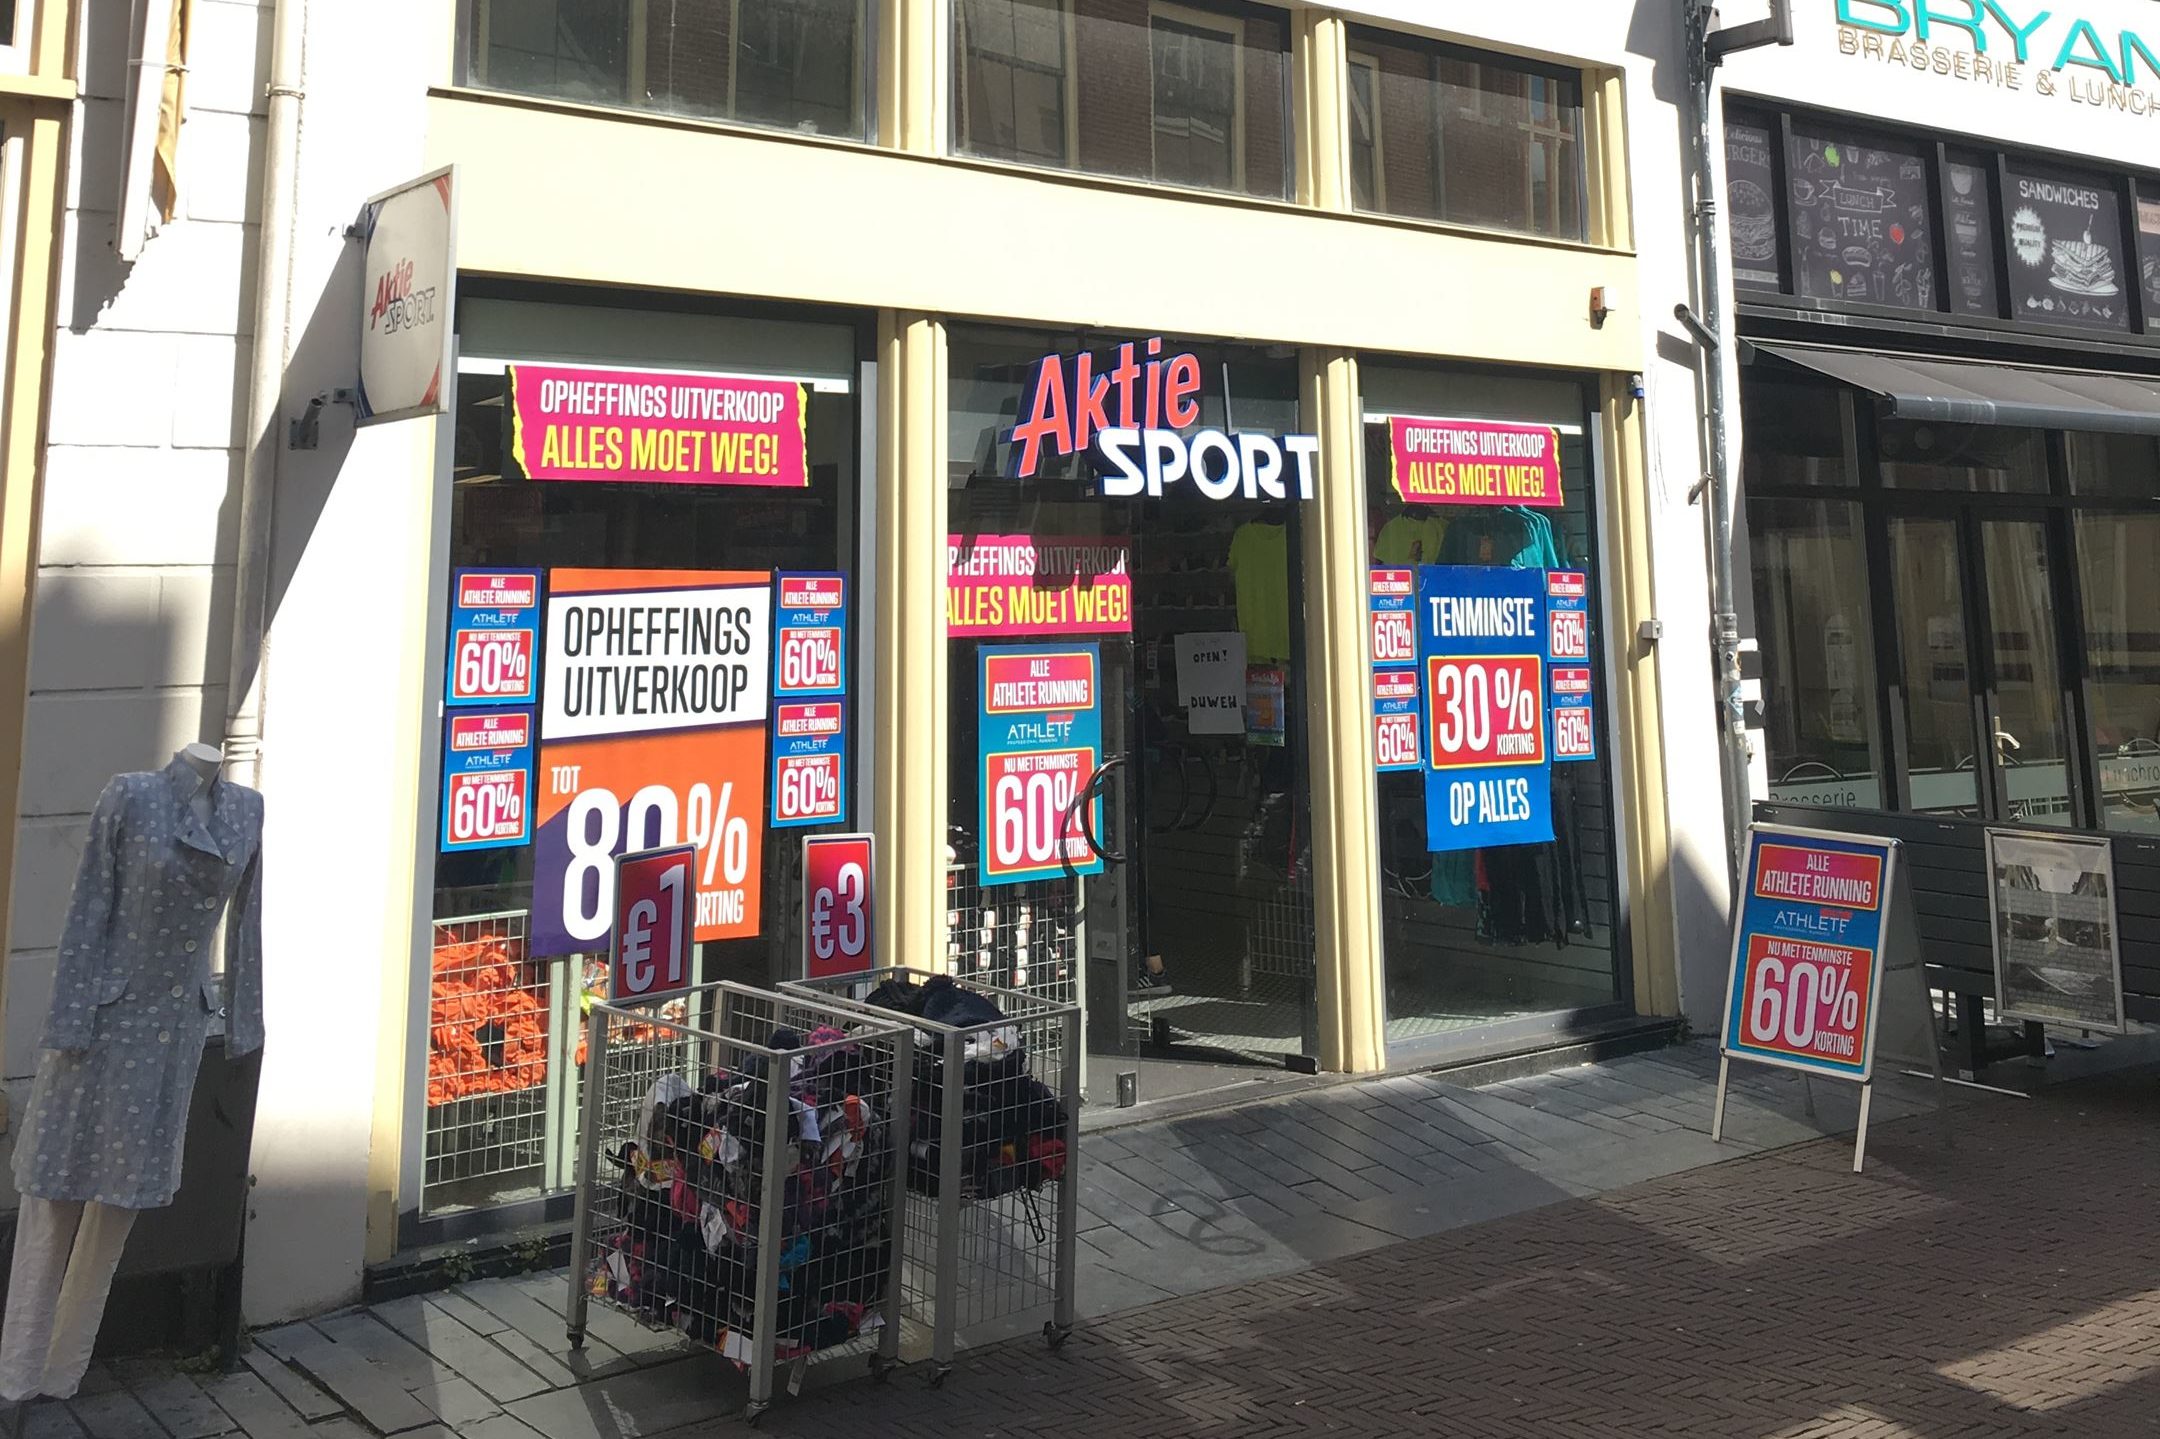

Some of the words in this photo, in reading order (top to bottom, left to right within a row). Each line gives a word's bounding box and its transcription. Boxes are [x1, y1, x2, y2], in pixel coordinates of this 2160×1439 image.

[1838, 26, 2023, 90] BRASSERIE
[2035, 69, 2057, 97] &
[1840, 192, 1874, 209] LUNCH
[2019, 180, 2099, 210] SANDWICHES
[1838, 216, 1883, 239] TIME
[370, 257, 414, 331] Aktie
[384, 286, 435, 335] SPORT
[540, 379, 667, 419] OPHEFFINGS
[671, 386, 785, 424] UITVERKOOP
[1008, 336, 1201, 479] Aktie
[540, 424, 624, 471] ALLES
[630, 427, 706, 473] MOET
[710, 430, 780, 476] WEG!
[1405, 427, 1478, 456] OPHEFFINGS
[1480, 432, 1546, 459] UITVERKOOP
[1098, 427, 1319, 500] SPORT
[1408, 461, 1456, 496] ALLES
[1459, 463, 1502, 497] MOET
[1504, 466, 1546, 498] WEG!
[948, 545, 1036, 576] PHEFFINGS
[1038, 545, 1130, 576] UITVERKOOP
[464, 590, 495, 604] ATHLETE
[496, 590, 530, 604] RUNNING
[490, 578, 505, 588] ALLE
[946, 586, 1003, 626] ALLES
[1008, 583, 1071, 625] MOET
[1073, 584, 1129, 623] WEG!
[1429, 596, 1535, 637] TENMINSTE
[563, 606, 752, 658] OPHEFFINGS
[1374, 620, 1411, 659] 60%
[1553, 619, 1583, 655] 60%
[460, 641, 526, 694] 60%
[784, 638, 836, 686] 60%
[1030, 659, 1050, 677] ALLE
[1193, 649, 1228, 663] OPEN!
[563, 663, 748, 718] UITVERKOOP
[992, 681, 1037, 707] ATHLETE
[1038, 679, 1088, 705] RUNNING
[1437, 663, 1535, 752] 30%
[456, 732, 487, 747] ATHLETE
[488, 729, 524, 745] RUNNING
[483, 718, 498, 729] ALLE
[1558, 716, 1588, 753] 60%
[1378, 723, 1415, 763] 60%
[1496, 733, 1535, 756] KORTING
[551, 765, 581, 795] TOT
[1004, 757, 1016, 773] NU
[1017, 756, 1034, 773] MET
[1034, 753, 1078, 771] TENMINSTE
[782, 765, 835, 816] 60%
[1450, 780, 1475, 826] OP
[1478, 777, 1530, 823] ALLES
[454, 783, 520, 839] 60%
[1055, 838, 1088, 860] KRTING
[1806, 854, 1830, 873] ALLE
[1762, 870, 1812, 897] ATHLETE
[1813, 875, 1872, 904] RUNNING
[622, 863, 686, 993] €1
[812, 861, 866, 960] €3
[1767, 940, 1781, 957] NU
[1781, 943, 1801, 959] MET
[1801, 945, 1853, 967] TENMINSTE
[1750, 956, 1859, 1049] 60%
[1814, 1030, 1855, 1057] KORTING
